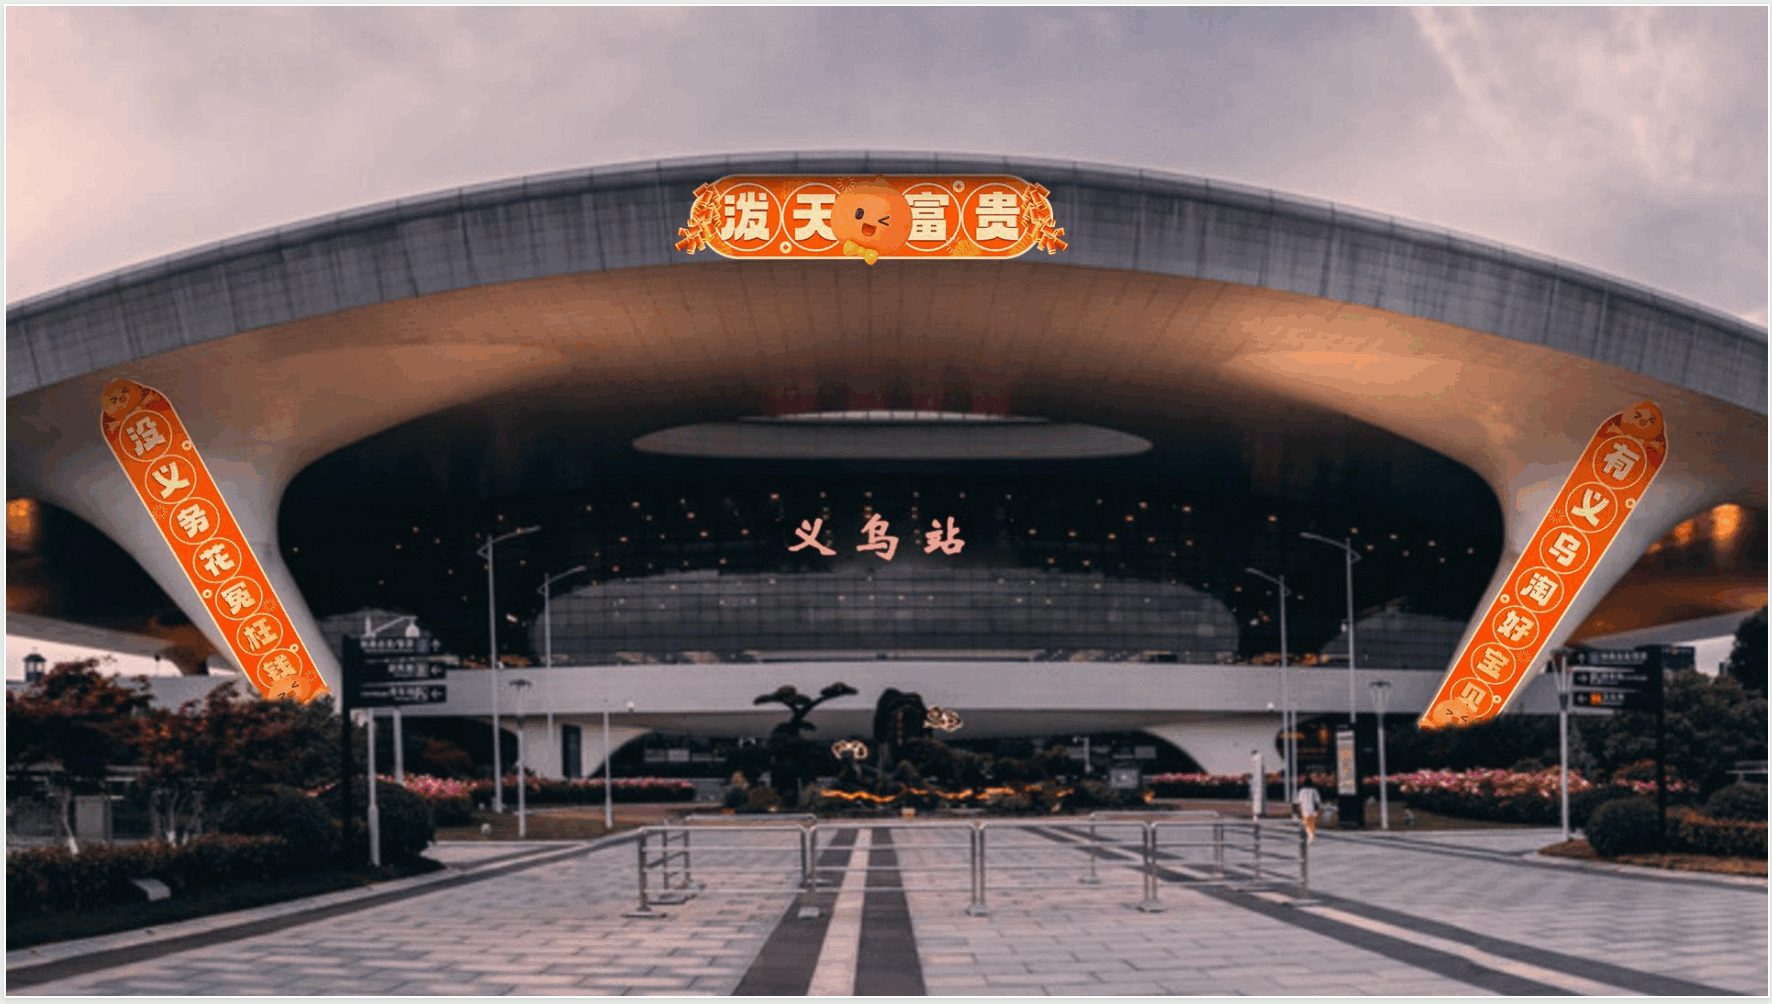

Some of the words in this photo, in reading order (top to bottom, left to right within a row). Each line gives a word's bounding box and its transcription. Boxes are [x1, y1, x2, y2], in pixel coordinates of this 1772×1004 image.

[721, 191, 1020, 242] 泼天富贵
[126, 416, 297, 682] 没义务花冤枉钱
[787, 513, 966, 561] 义乌站
[1456, 442, 1640, 713] 有义乌淘好宝贝
